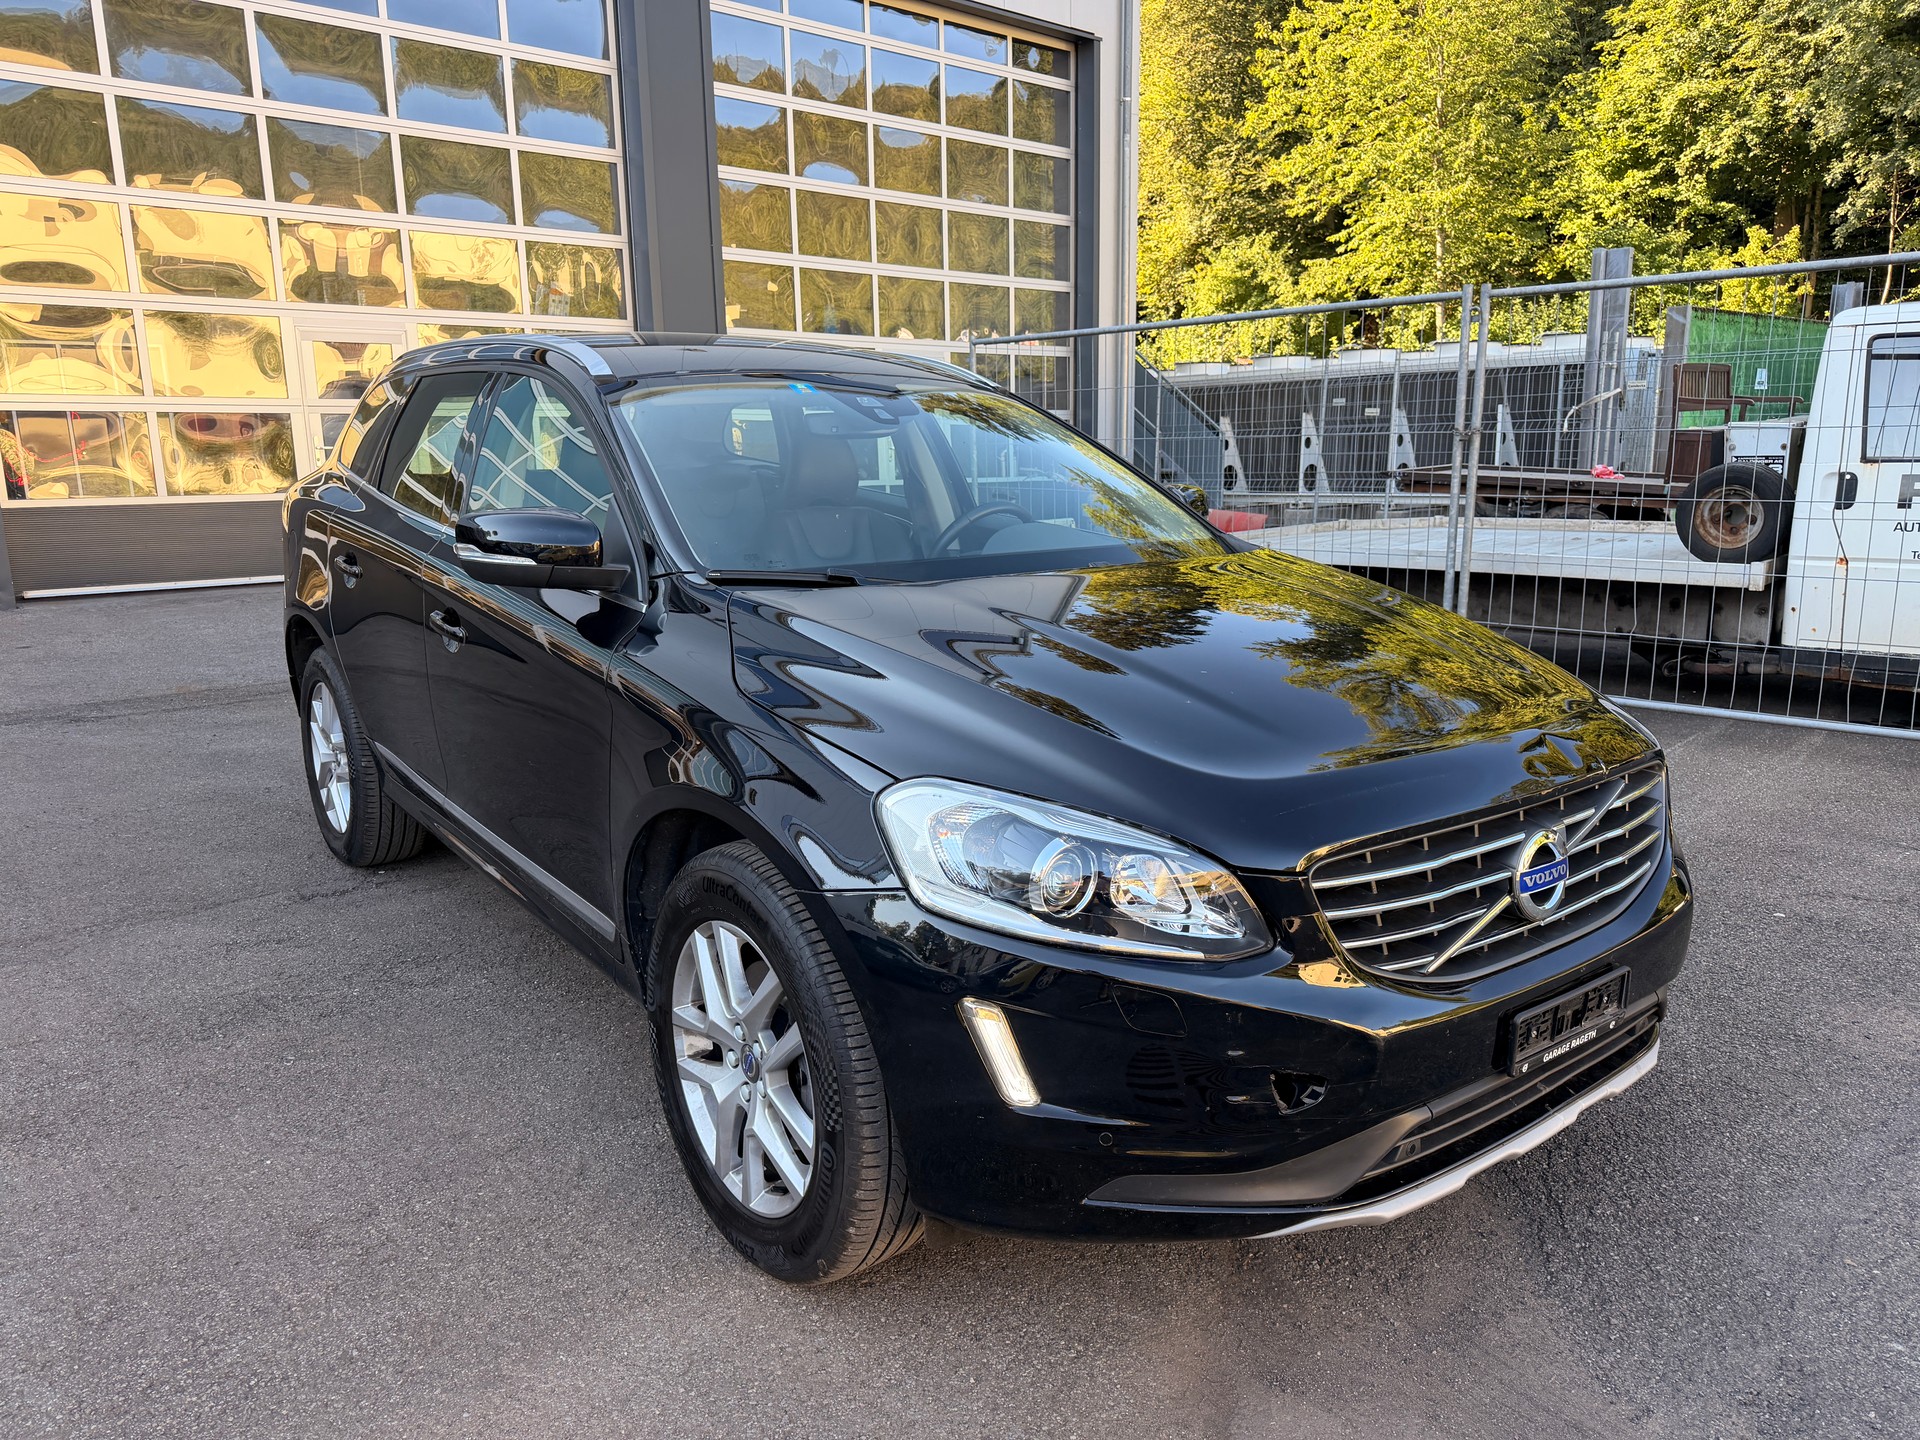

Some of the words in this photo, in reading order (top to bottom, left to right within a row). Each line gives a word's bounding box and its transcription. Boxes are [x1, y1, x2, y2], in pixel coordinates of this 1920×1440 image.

[1523, 864, 1566, 887] VOLVO
[1543, 1042, 1570, 1062] GARAGE
[1571, 1029, 1597, 1049] RAGETH
